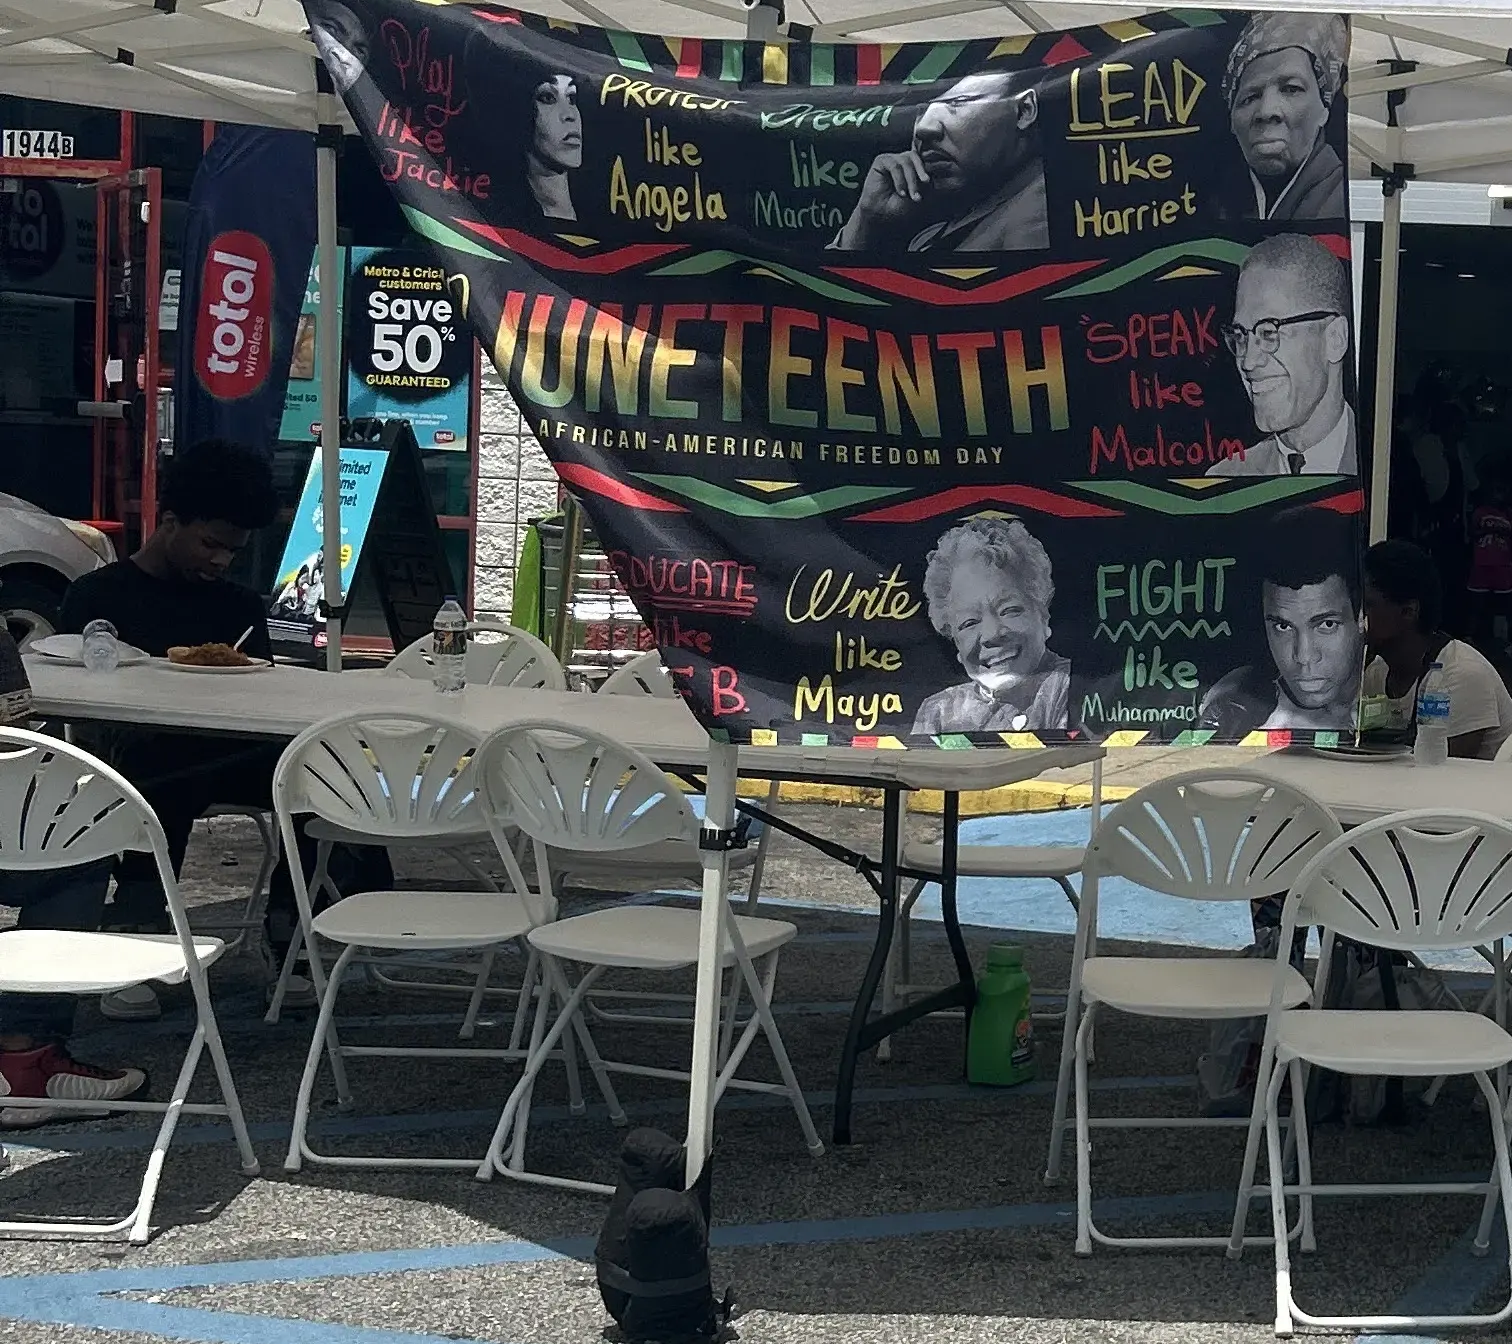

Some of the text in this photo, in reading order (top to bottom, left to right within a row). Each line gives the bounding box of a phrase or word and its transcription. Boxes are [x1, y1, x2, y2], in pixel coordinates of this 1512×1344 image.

[1069, 59, 1207, 131] LEAD
[645, 117, 702, 166] like
[790, 140, 859, 189] like
[1099, 141, 1173, 185] like
[381, 148, 490, 199] Jackie
[610, 156, 727, 232] Angela
[755, 191, 844, 228] Martin
[1075, 182, 1196, 237] Harriet
[364, 266, 399, 278] Metro
[401, 267, 411, 278] &
[379, 280, 442, 291] customers
[208, 250, 258, 374] total
[368, 291, 453, 323] Save
[244, 315, 265, 378] wireless
[366, 374, 450, 388] GUARANTEED
[1130, 370, 1204, 409] like
[538, 419, 1003, 466] AFRICAN-AMERICAN FREEDOM DAY
[1089, 418, 1245, 475] Malcolm
[785, 563, 921, 623] Write
[1097, 557, 1236, 620] FIGHT
[835, 631, 902, 672] like
[1124, 646, 1199, 691] like
[794, 675, 903, 731] Maya
[1081, 692, 1199, 723] Muhammad
